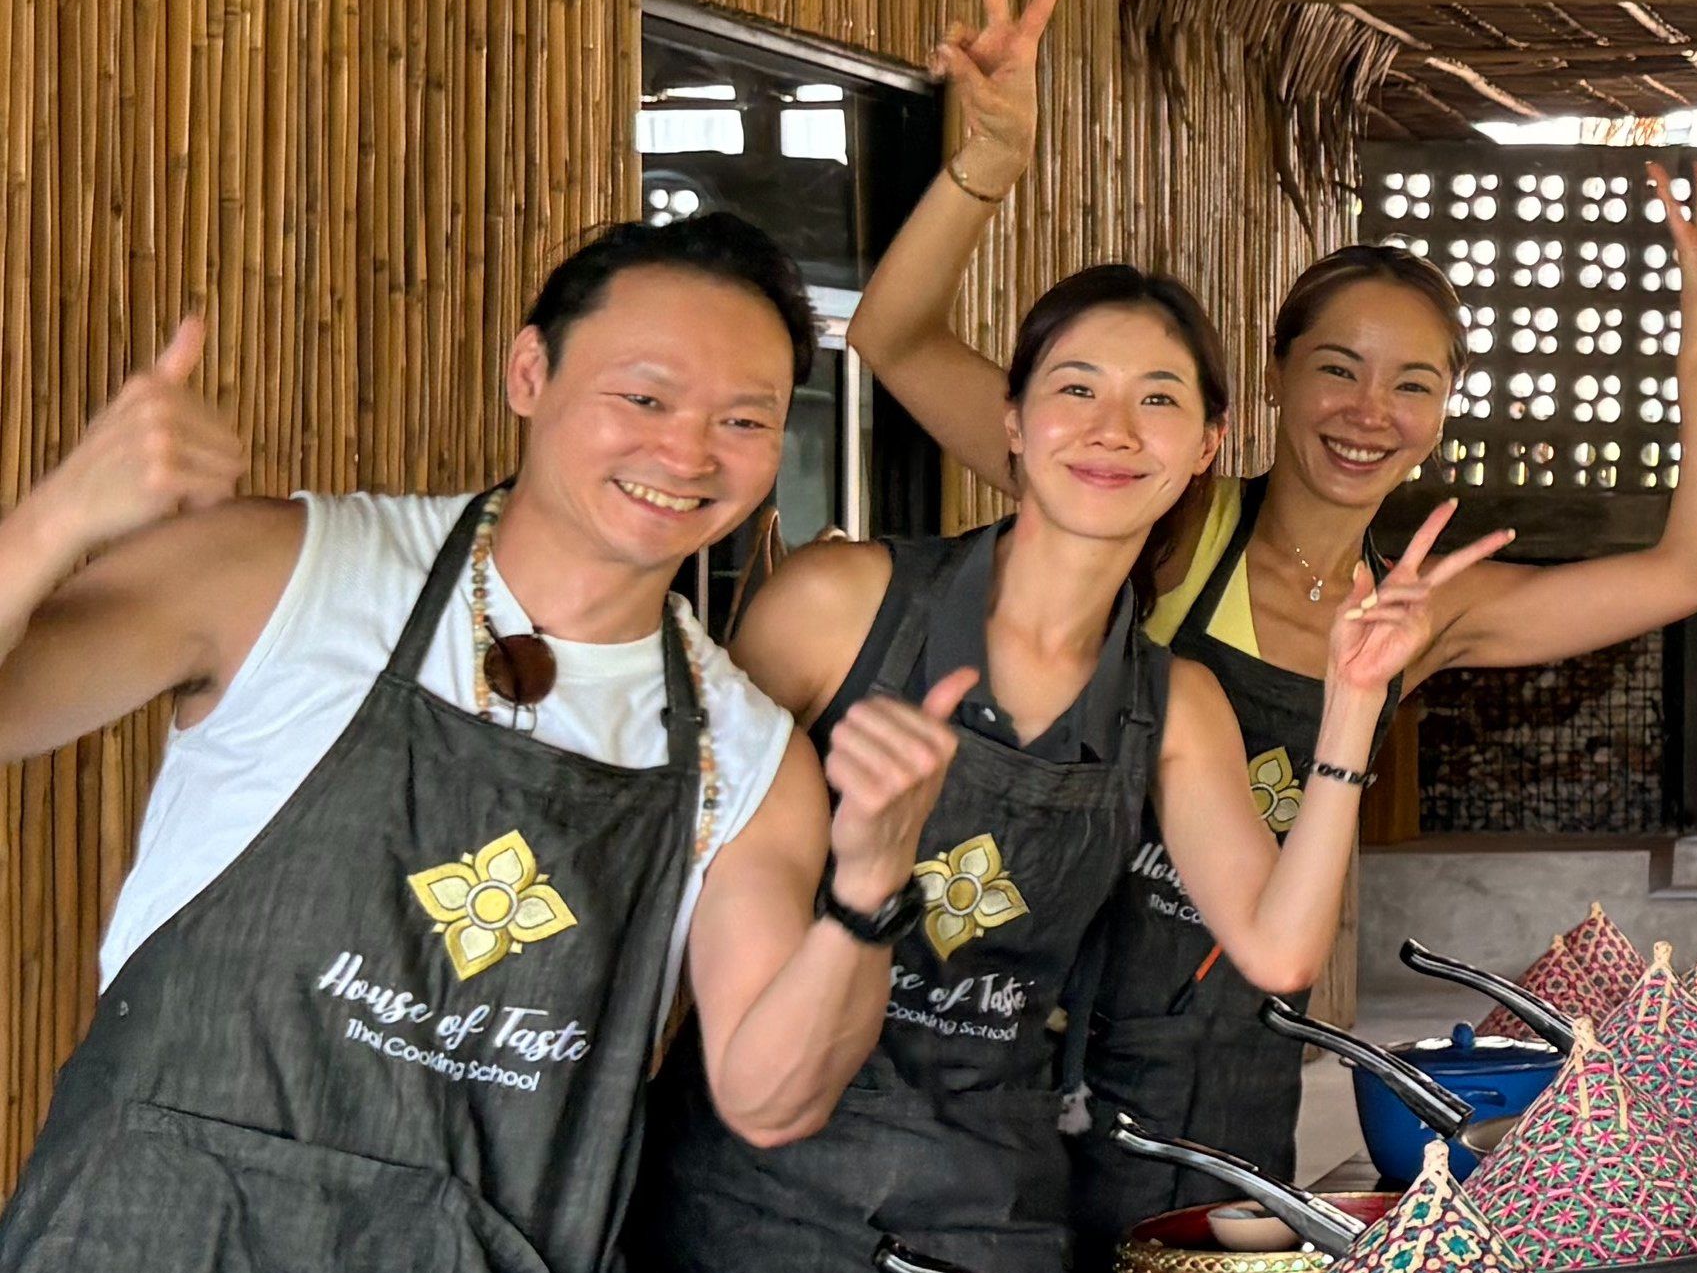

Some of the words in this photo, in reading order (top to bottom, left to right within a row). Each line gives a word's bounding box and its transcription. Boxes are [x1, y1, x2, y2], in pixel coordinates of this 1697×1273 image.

[318, 951, 433, 1024] House
[436, 1004, 491, 1050] of
[494, 1006, 591, 1062] Taste
[928, 978, 975, 1013] of
[345, 1018, 383, 1052] Thai
[383, 1037, 466, 1081] Cooking
[467, 1060, 541, 1092] School
